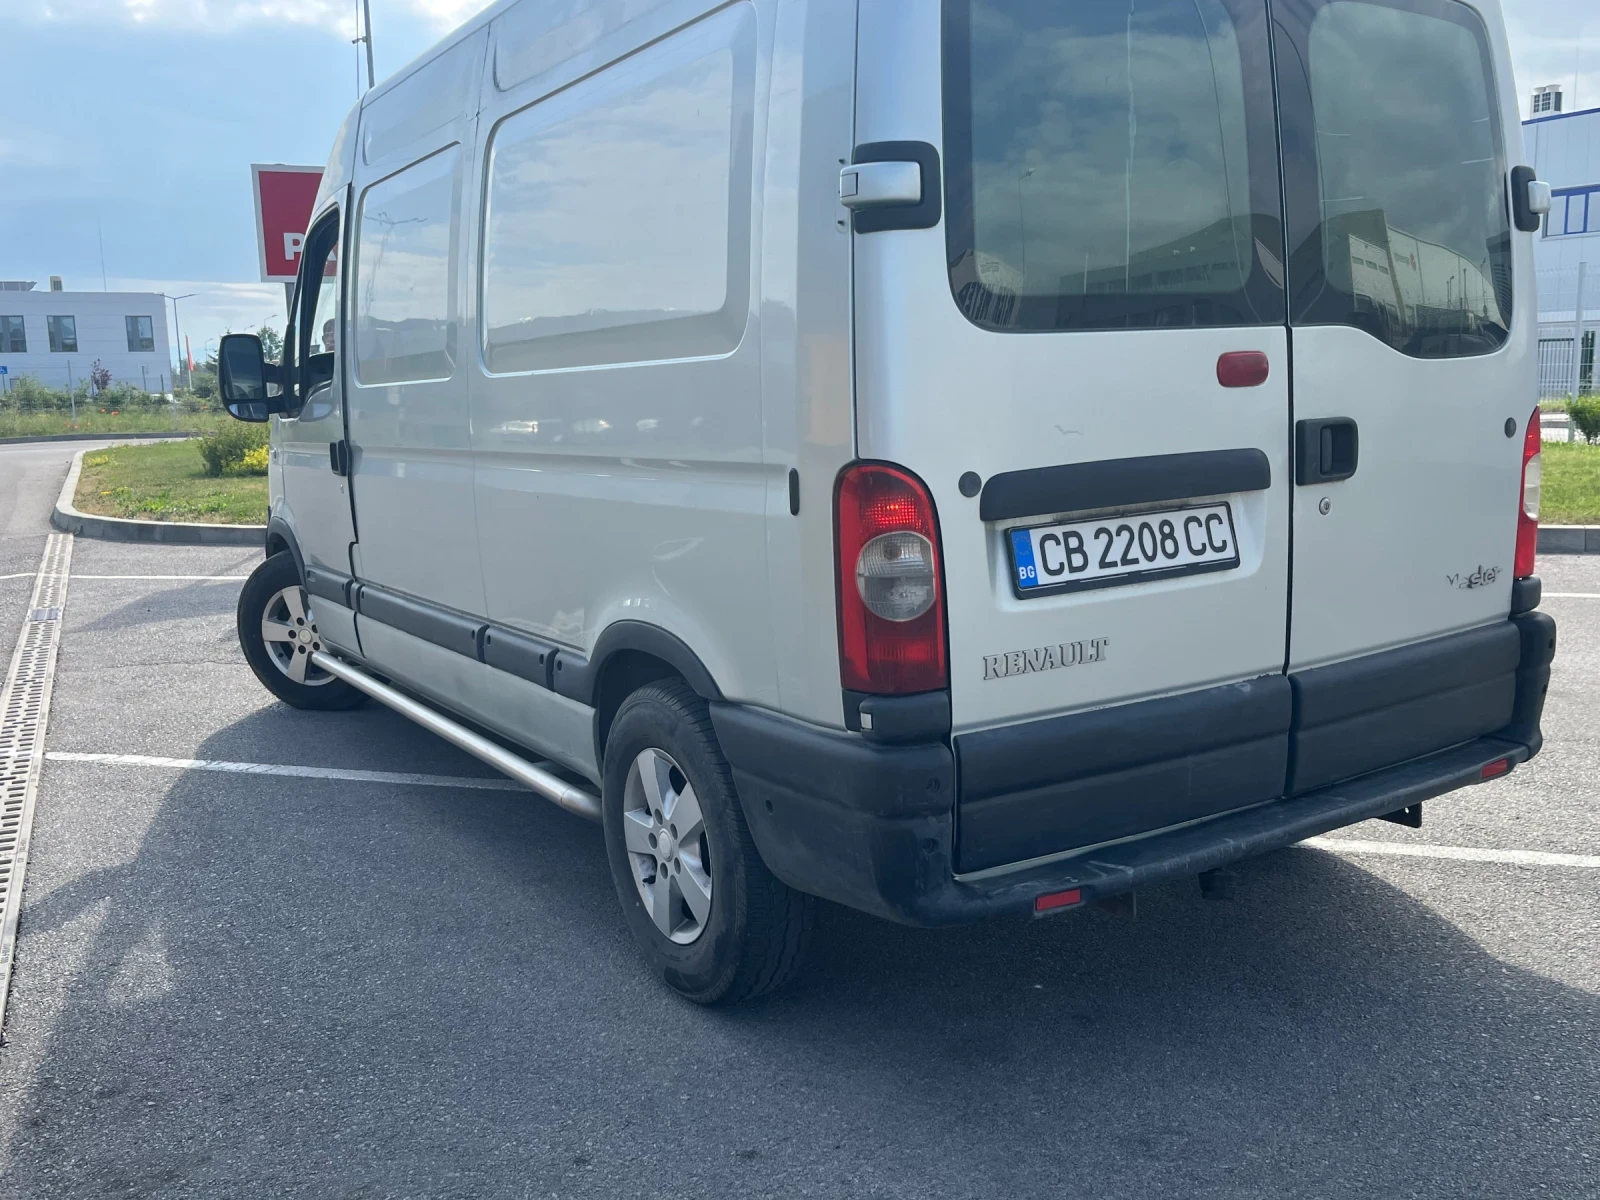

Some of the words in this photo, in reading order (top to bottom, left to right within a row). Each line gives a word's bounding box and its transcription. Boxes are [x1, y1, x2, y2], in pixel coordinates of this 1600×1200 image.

[1039, 530, 1089, 576] CB
[1093, 519, 1180, 570] 2208
[1183, 513, 1228, 556] CC
[1018, 565, 1035, 580] BG
[983, 636, 1110, 680] RENAULT
